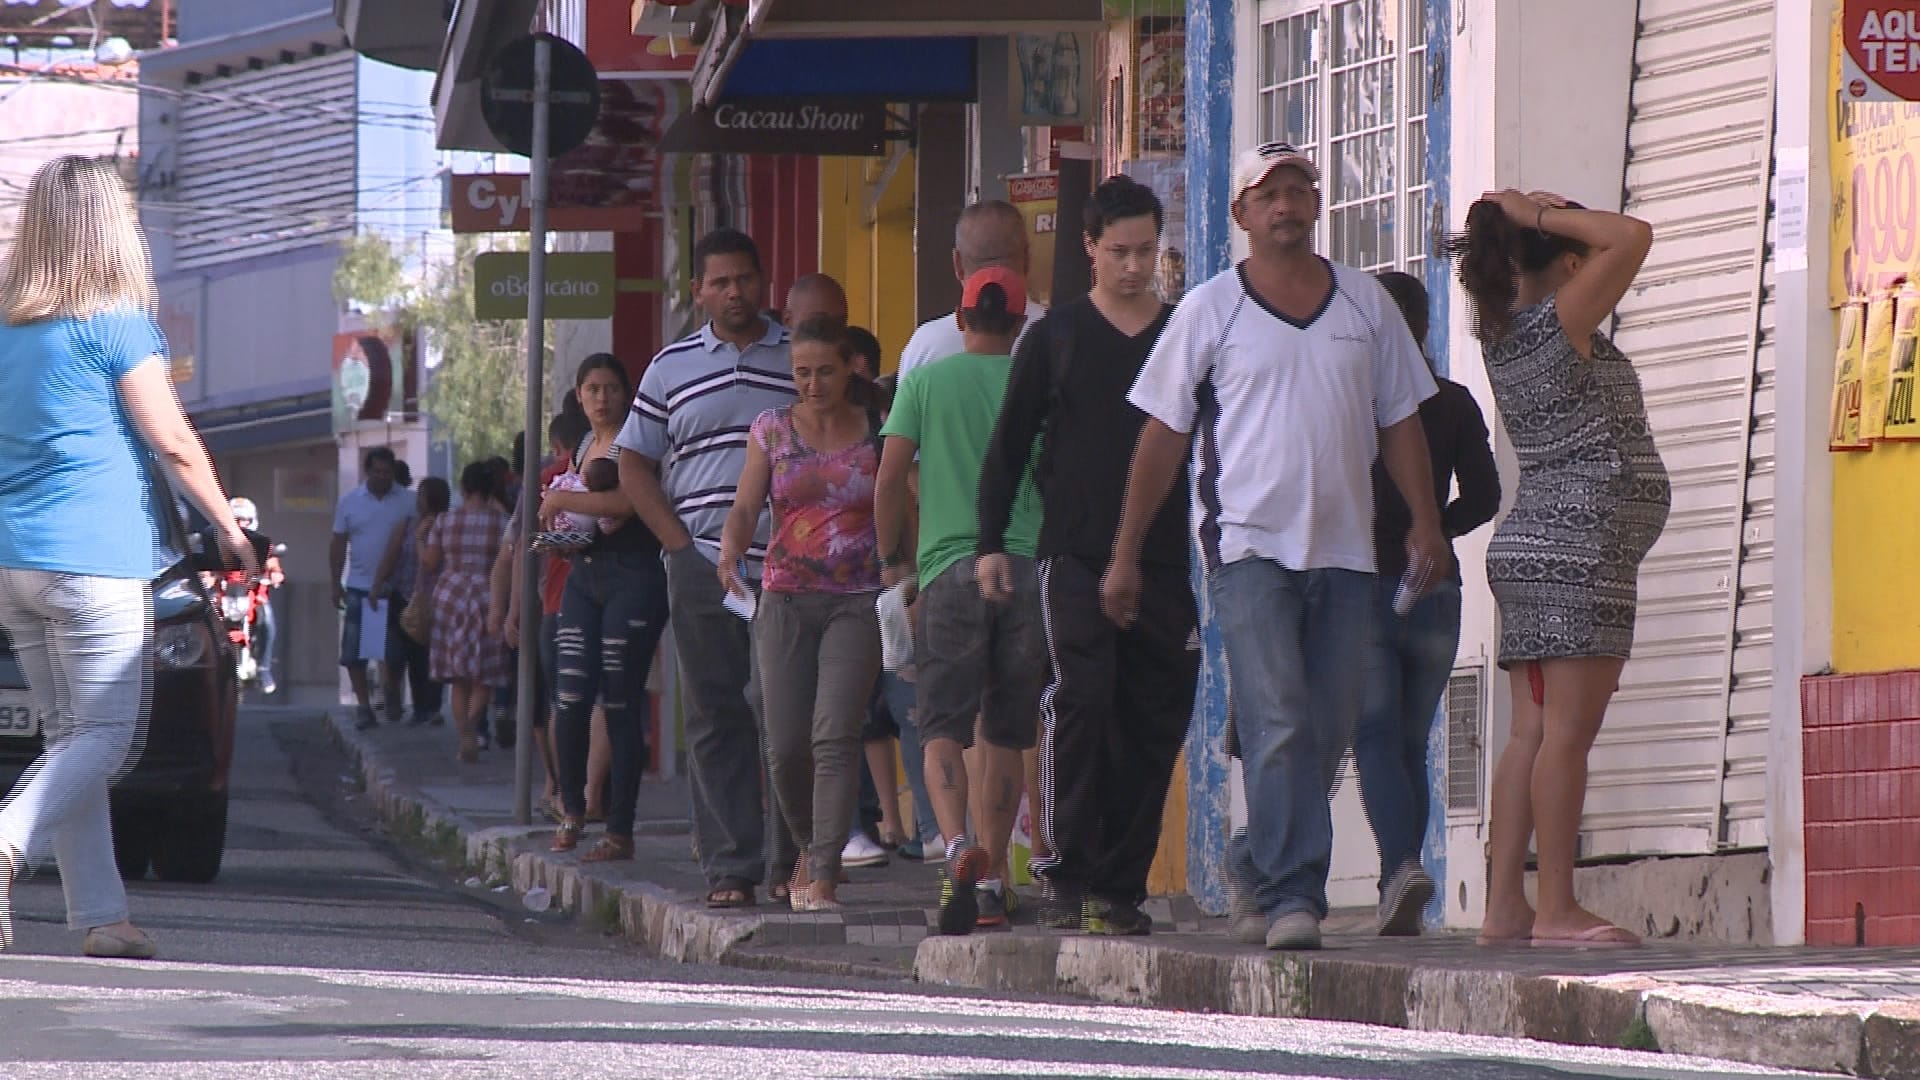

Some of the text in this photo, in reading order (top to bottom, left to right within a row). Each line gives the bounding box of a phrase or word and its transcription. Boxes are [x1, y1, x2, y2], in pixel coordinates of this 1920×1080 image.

[714, 103, 864, 130] Cacau Show
[1886, 376, 1916, 426] AZUL
